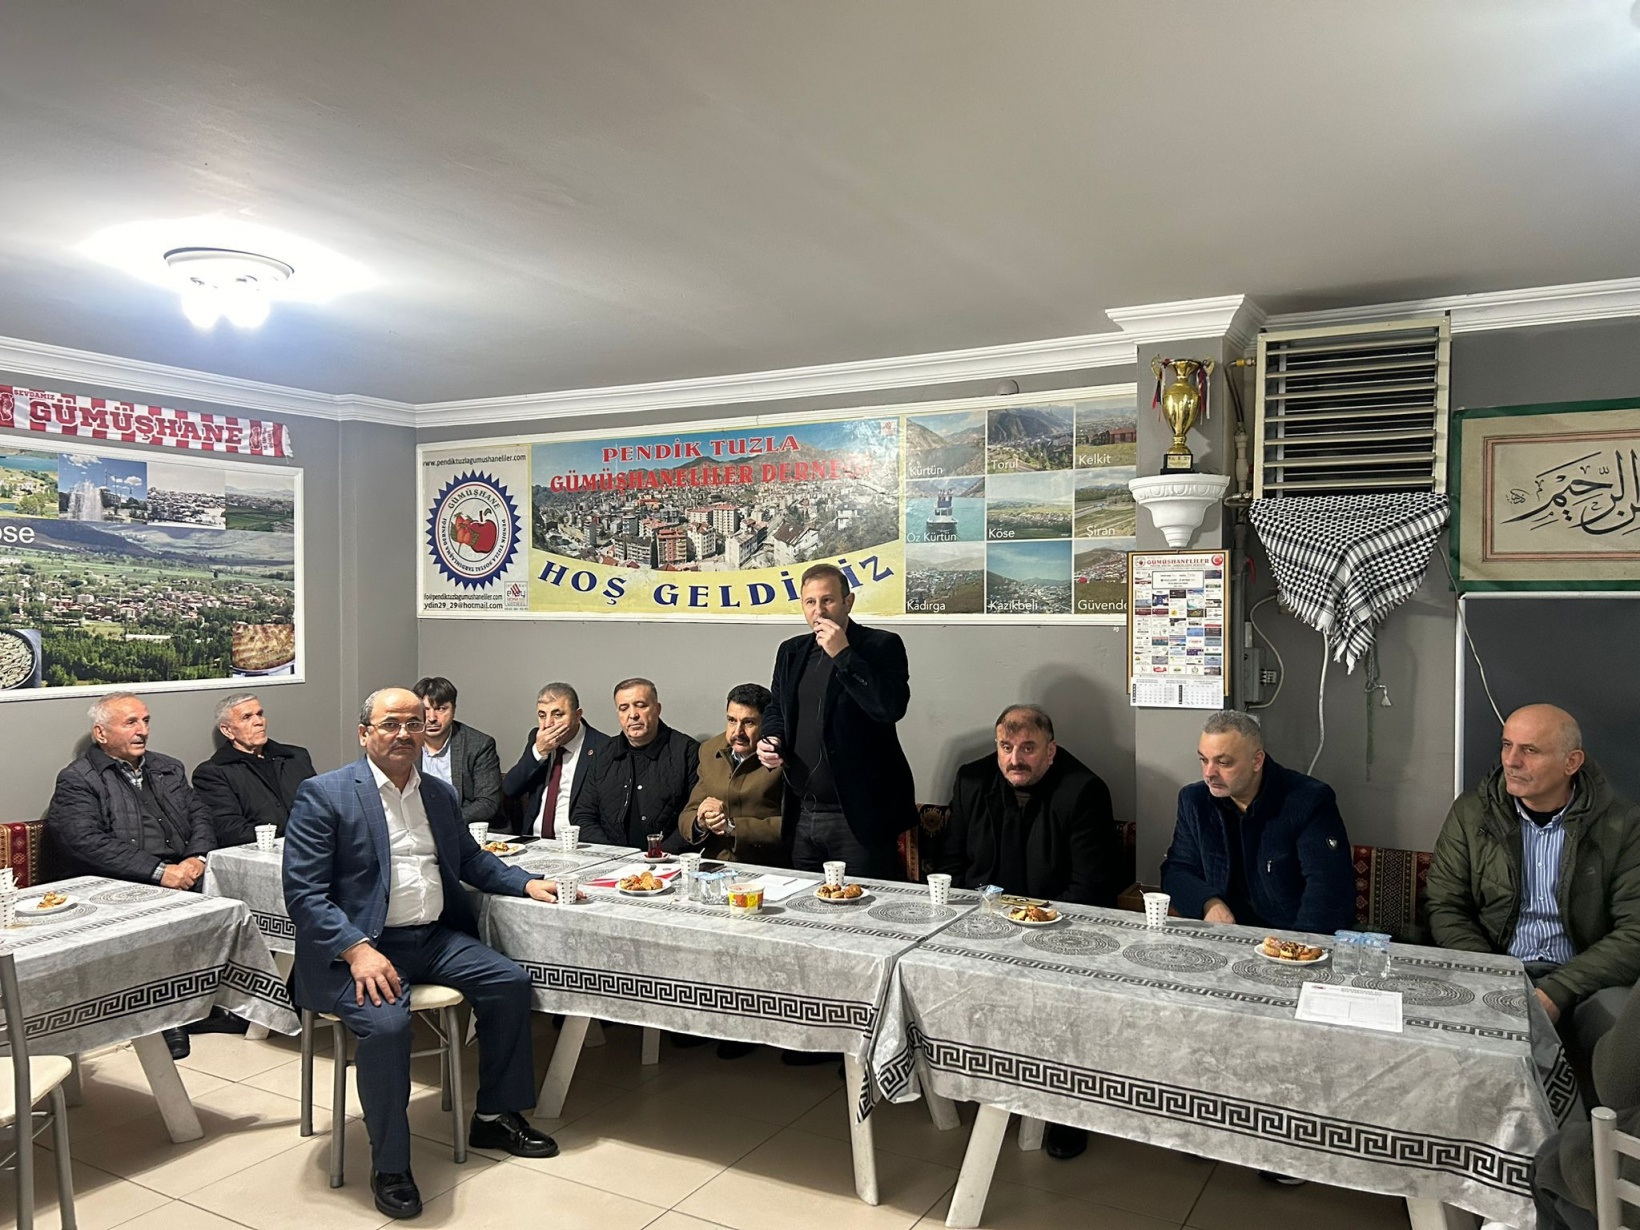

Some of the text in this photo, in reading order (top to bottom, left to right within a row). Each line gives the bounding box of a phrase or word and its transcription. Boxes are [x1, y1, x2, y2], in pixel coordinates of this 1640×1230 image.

[13, 389, 56, 401] SEVDAMIZ
[29, 396, 244, 446] GÜMÜŞHANE
[601, 434, 800, 463] PENDİK TUZLA
[991, 458, 1019, 470] Torul
[1078, 453, 1112, 466] Kelkit
[909, 465, 943, 477] Kürtün
[550, 460, 753, 497] GÜMÜŞHANELİLER
[447, 488, 501, 510] GÜMÜŞHANE
[0, 525, 35, 544] se
[923, 531, 957, 542] Kürtün
[988, 527, 1016, 540] Köse
[1086, 525, 1116, 538] Şiran
[537, 555, 895, 608] HOŞ GELDİİZ
[907, 600, 946, 613] Kadırga
